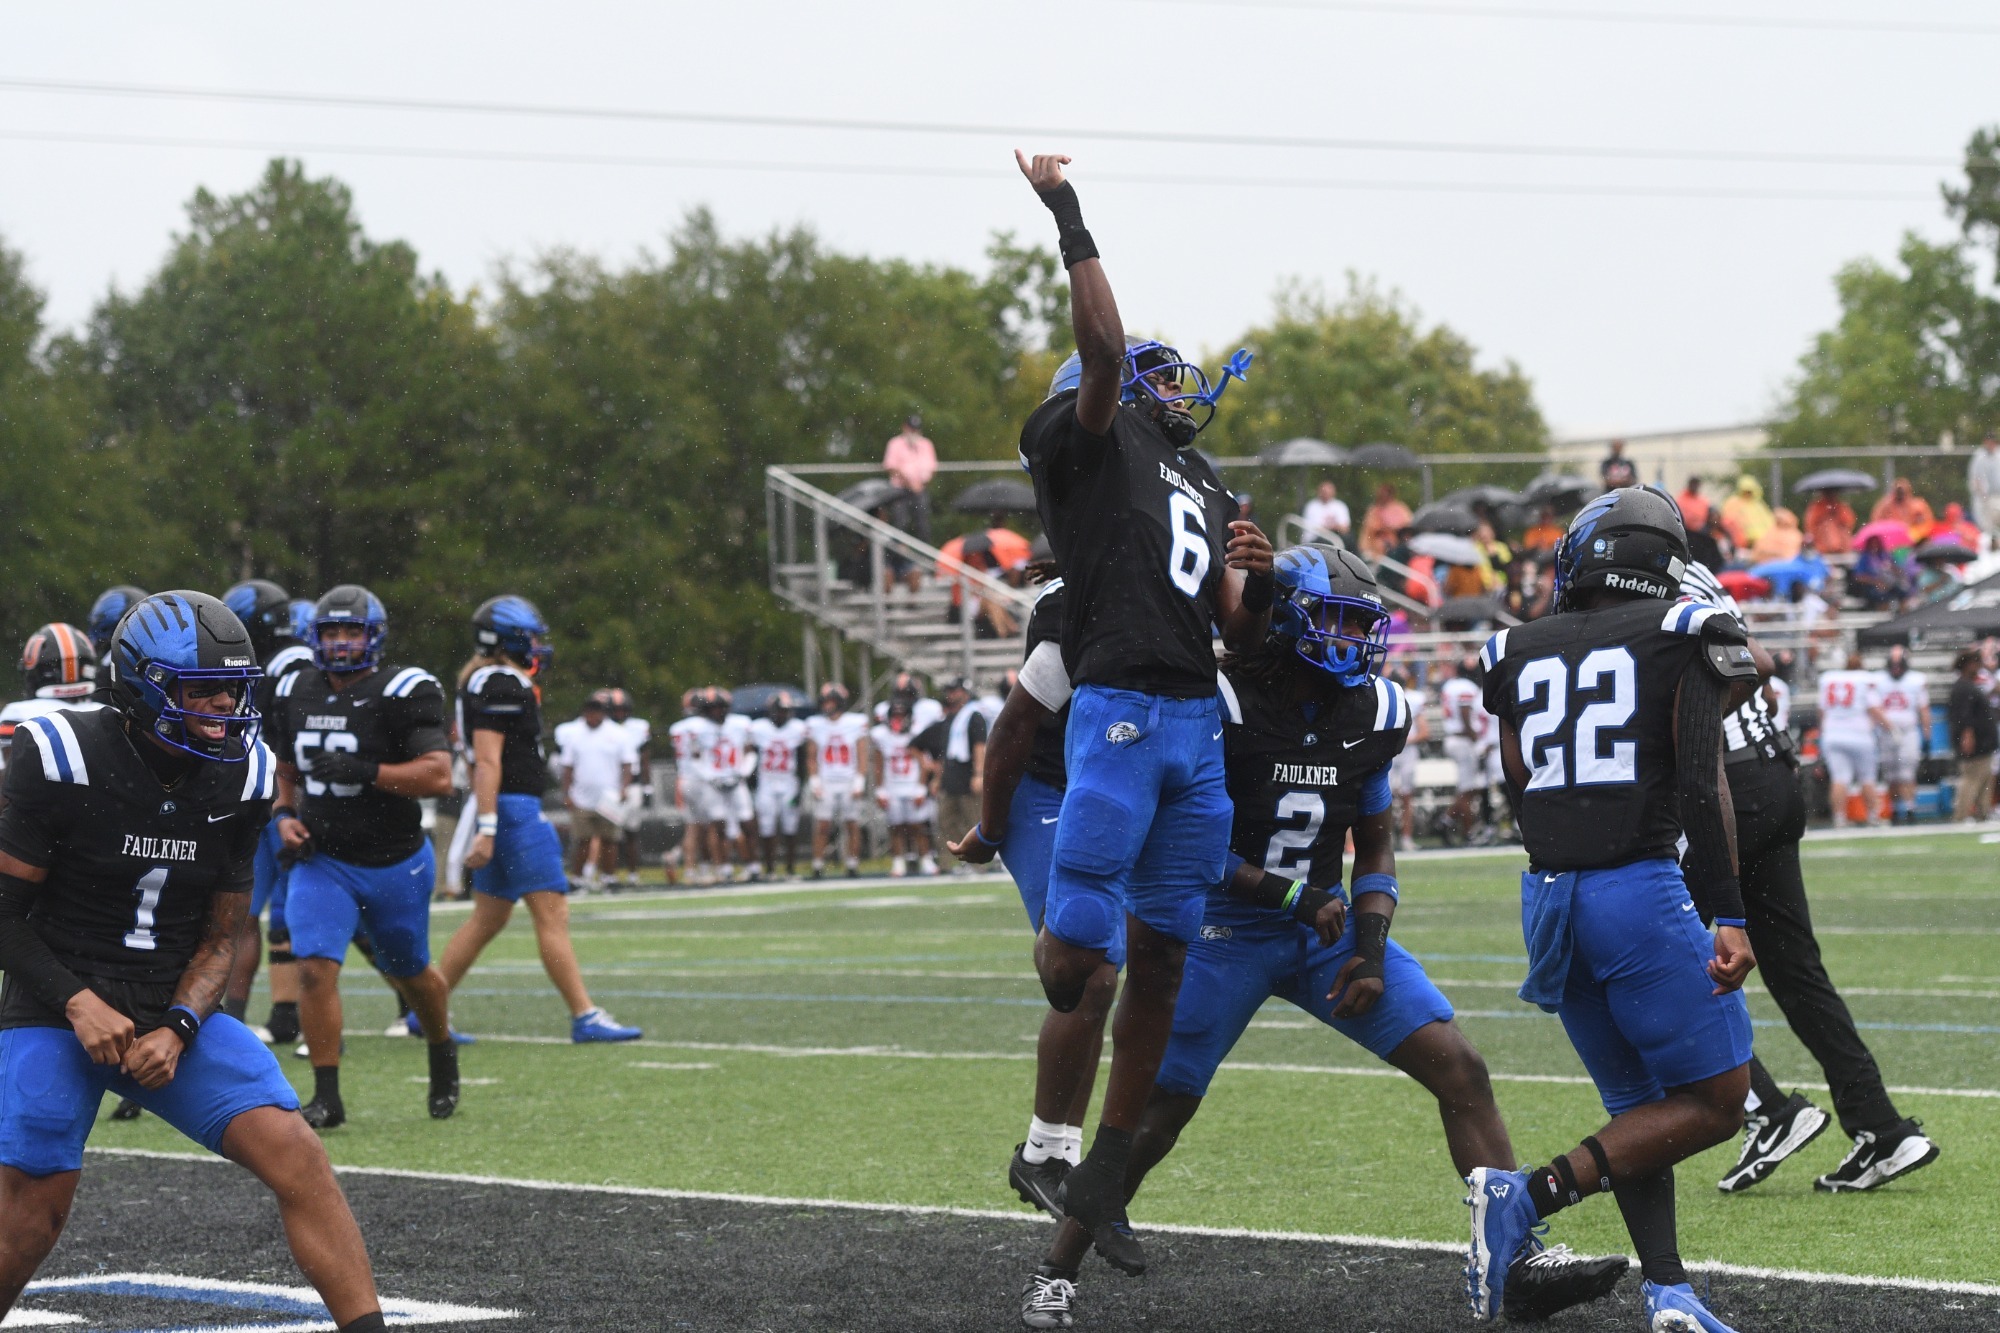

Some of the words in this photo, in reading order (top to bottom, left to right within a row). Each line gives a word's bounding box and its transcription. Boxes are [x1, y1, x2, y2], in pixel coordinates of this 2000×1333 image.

[1168, 490, 1211, 599] 6
[1605, 573, 1668, 599] Riddell
[1517, 645, 1639, 793] 22
[1272, 763, 1338, 786] FAULKNER
[121, 834, 198, 862] FAULKNER
[1263, 790, 1326, 885] 2
[123, 866, 171, 951] 1
